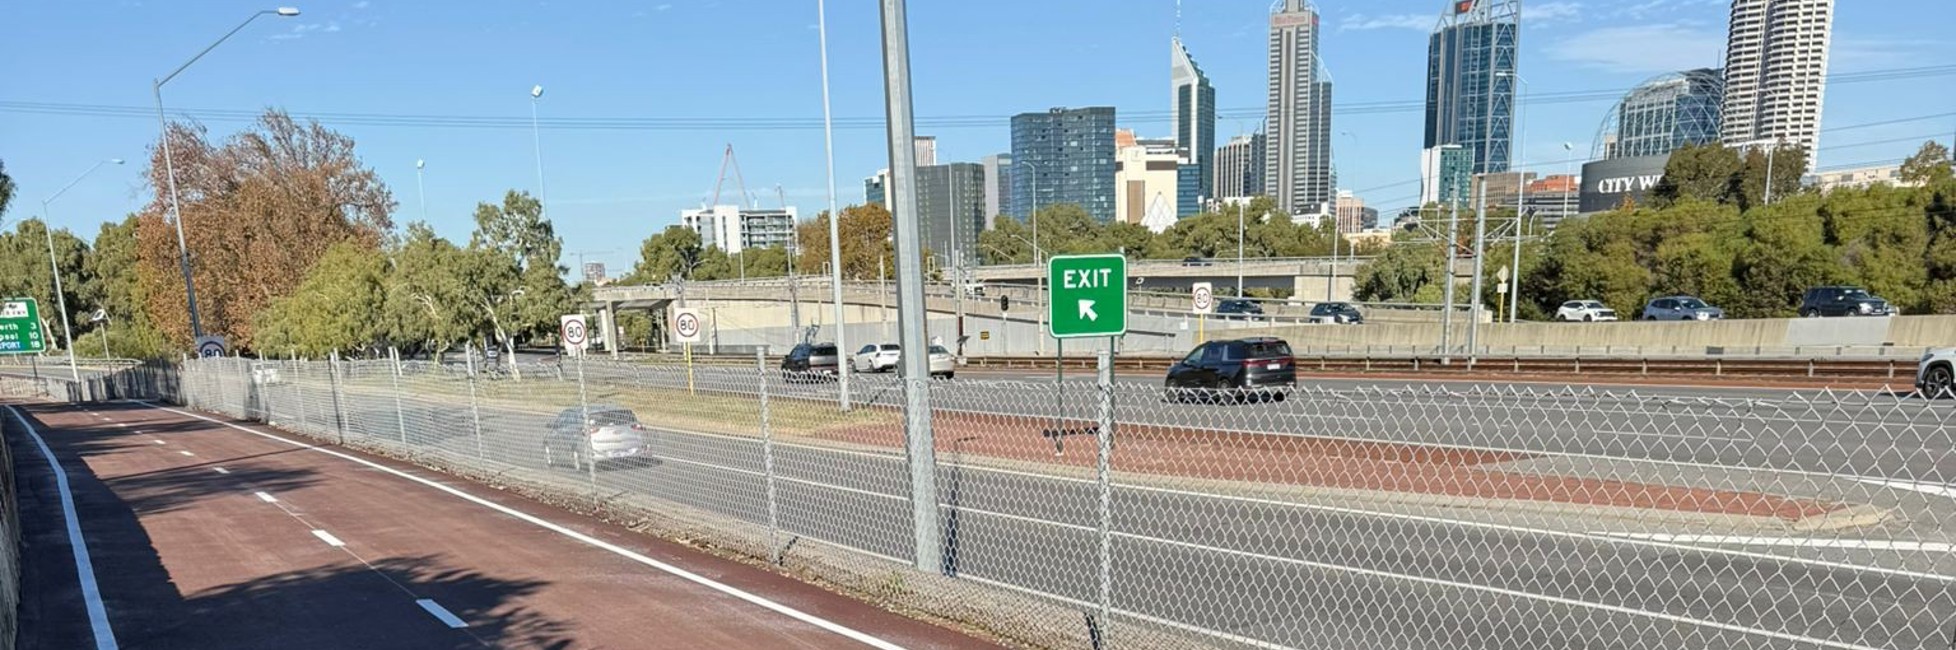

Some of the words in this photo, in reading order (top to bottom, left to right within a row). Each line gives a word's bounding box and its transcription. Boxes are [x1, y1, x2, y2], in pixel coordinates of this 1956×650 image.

[1598, 176, 1635, 194] CITY
[1064, 268, 1112, 289] EXIT
[1197, 293, 1207, 303] 80
[680, 319, 694, 330] 80
[29, 331, 38, 339] 10
[568, 326, 582, 337] 80
